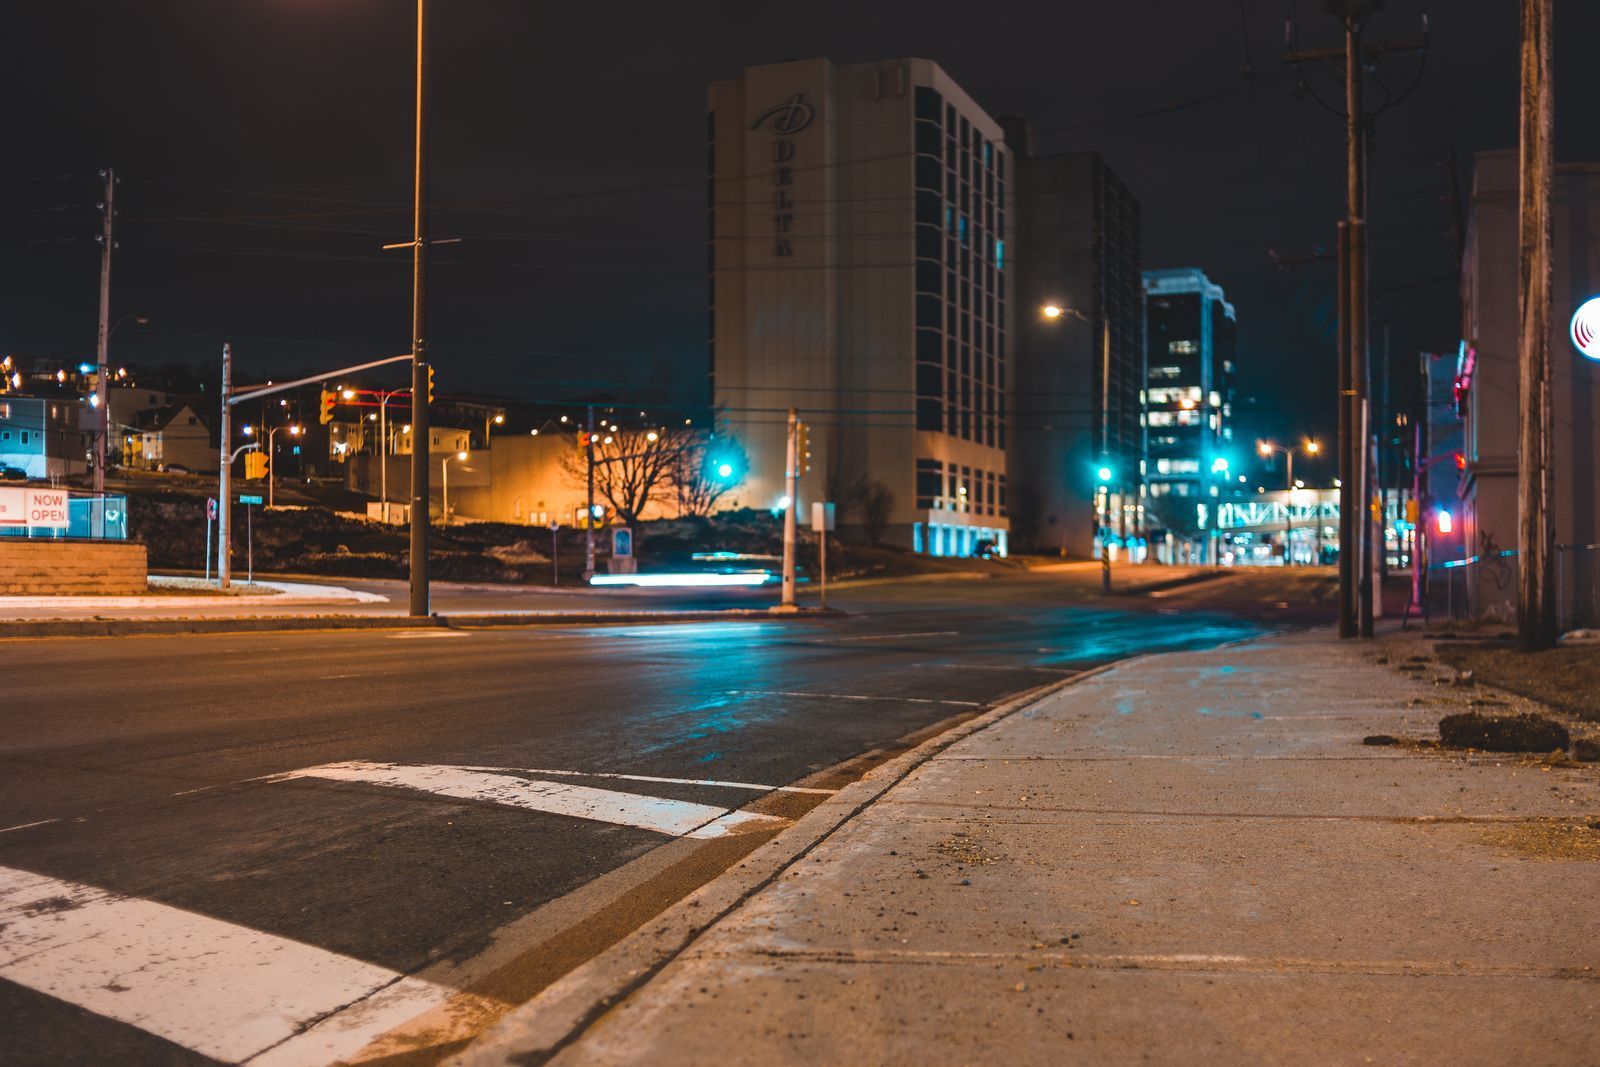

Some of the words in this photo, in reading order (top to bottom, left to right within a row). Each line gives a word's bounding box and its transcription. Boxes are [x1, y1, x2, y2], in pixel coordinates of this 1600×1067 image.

[772, 140, 795, 257] DELTA
[33, 494, 63, 507] NOW
[31, 509, 65, 521] OPEN
